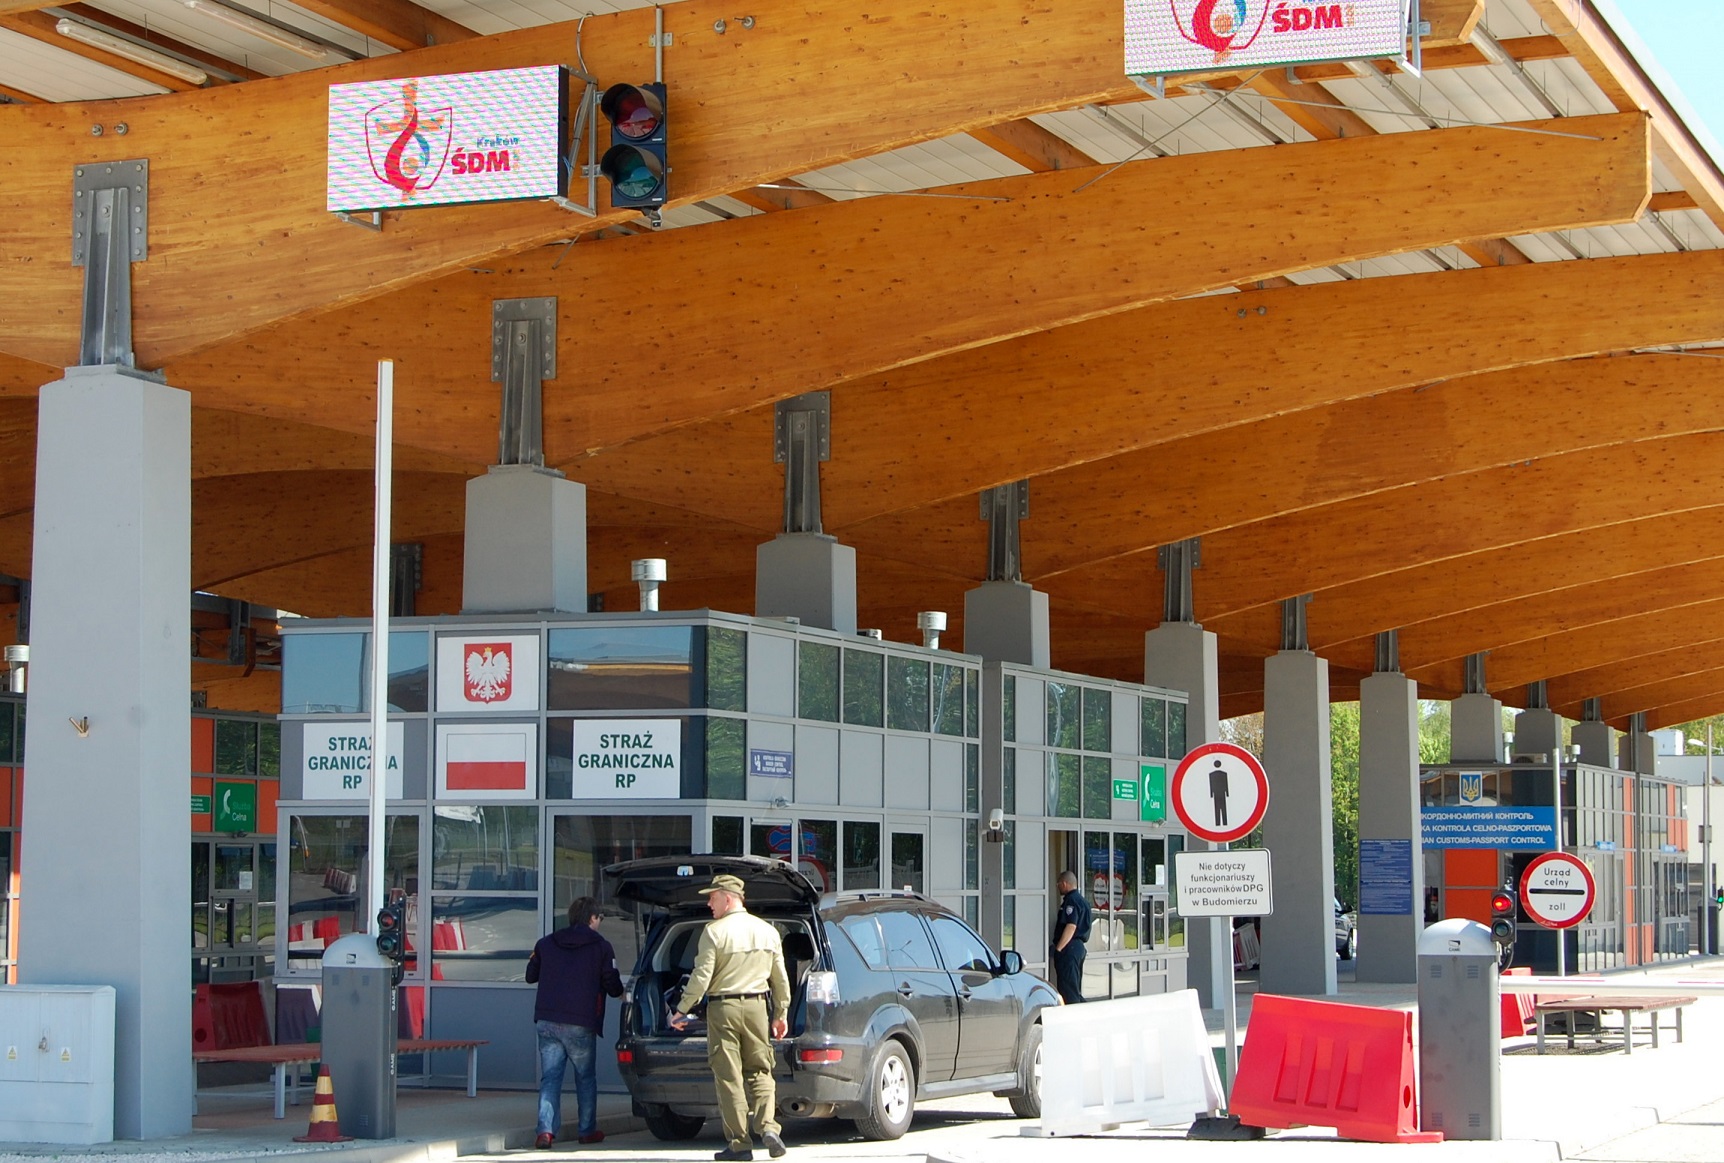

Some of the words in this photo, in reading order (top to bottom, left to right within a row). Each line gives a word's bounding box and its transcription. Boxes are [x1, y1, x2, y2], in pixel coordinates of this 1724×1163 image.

[1272, 2, 1344, 33] ŚDM
[451, 146, 510, 175] ŚDM
[328, 736, 372, 751] STRA
[600, 730, 653, 748] STRAŻ
[308, 755, 398, 770] GRANICA
[578, 753, 674, 768] GRANICZNA
[343, 775, 362, 789] RP
[615, 773, 636, 788] RP
[1421, 812, 1493, 820] КОРДОННО-МИТНИЙ
[1473, 824, 1553, 832] CELNO-PASZPORTOWA
[1421, 836, 1434, 844] IAN
[1436, 836, 1508, 844] CUSTOMS-PASSPORT
[1511, 836, 1546, 844] CONTROL
[1199, 862, 1212, 870] Nie
[1214, 862, 1246, 872] dotyczy
[1190, 873, 1255, 884] funkcjonariuszy
[1544, 878, 1569, 888] celny
[1189, 884, 1242, 895] pracowników
[1243, 883, 1264, 892] DPG
[1202, 897, 1258, 906] Budomierzu
[1549, 902, 1566, 911] zoll
